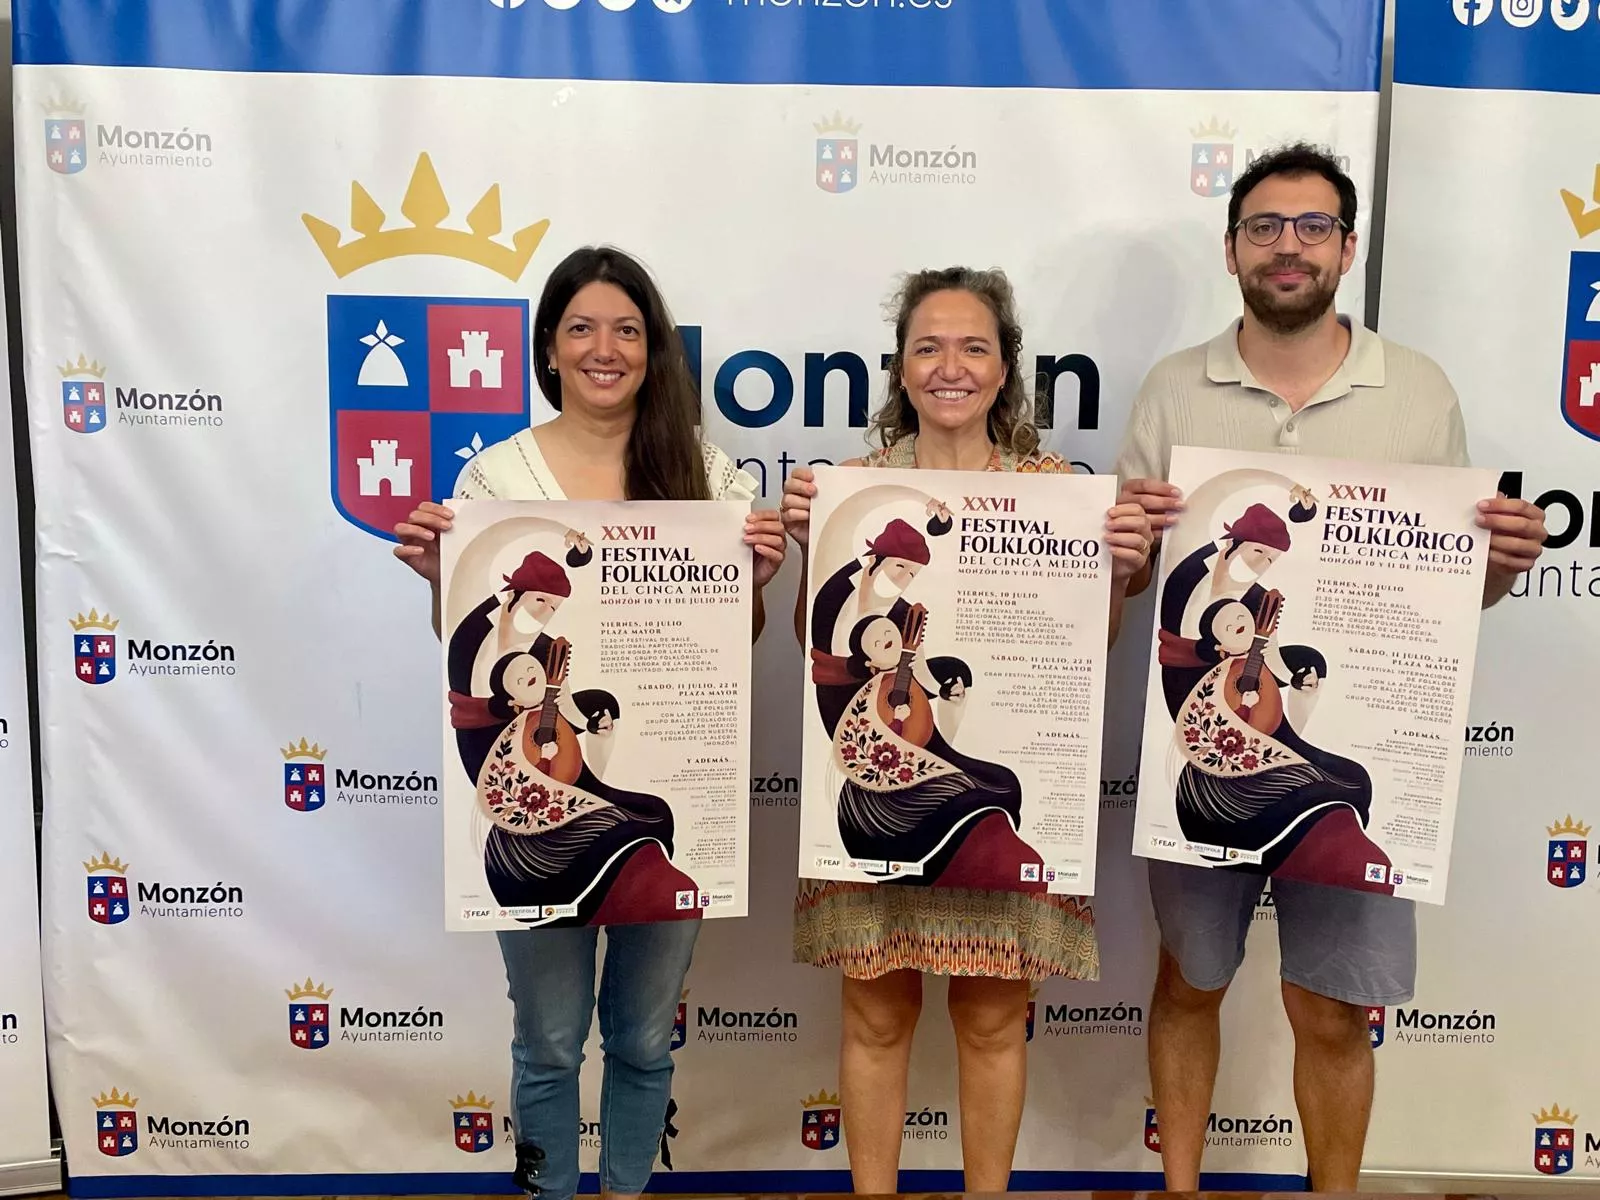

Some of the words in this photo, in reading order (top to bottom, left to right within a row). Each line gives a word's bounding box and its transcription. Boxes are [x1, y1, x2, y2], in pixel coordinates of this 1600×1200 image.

[97, 125, 211, 151] Monzón
[98, 151, 212, 168] Ayuntamiento
[870, 144, 976, 168] Monzón
[869, 170, 976, 185] Ayuntamiento
[116, 387, 222, 411] Monzón
[119, 412, 223, 427] Ayuntamiento
[1328, 484, 1386, 502] XXVII
[962, 496, 1016, 512] XXVII
[1325, 505, 1427, 527] FESTIVAL
[602, 525, 655, 540] XXVII
[961, 518, 1054, 534] FESTIVAL
[960, 535, 1099, 557] FOLKLÓRICO
[1322, 523, 1474, 553] FOLKLÓRICO
[602, 547, 694, 561] FESTIVAL
[959, 555, 986, 565] DEL
[992, 556, 1041, 567] CINCA
[1048, 558, 1098, 569] MEDIO
[1320, 543, 1350, 555] DEL
[1357, 546, 1409, 560] CINCA
[1417, 552, 1473, 565] MEDIO
[601, 561, 739, 582] FOLKLÓRICO
[958, 567, 997, 575] MONZÓN
[1046, 570, 1073, 578] JULIO
[1319, 555, 1361, 566] MONZÓN
[1399, 562, 1412, 570] DE
[1414, 564, 1444, 573] JULIO
[1447, 566, 1472, 576] 2026
[601, 585, 628, 595] DEL
[635, 585, 683, 594] CINCA
[690, 584, 739, 594] MEDIO
[1315, 587, 1344, 595] PLAZA
[1347, 590, 1380, 598] MAYOR
[1376, 584, 1404, 593] JULIO
[128, 640, 234, 661] Monzón
[129, 663, 235, 676] Ayuntamiento
[1392, 659, 1422, 667] PLAZA
[1425, 662, 1458, 671] MAYOR
[336, 769, 437, 791] Monzón
[750, 772, 798, 793] zón
[337, 791, 437, 805] Ayuntamiento
[1158, 840, 1176, 848] FEAF
[138, 882, 242, 903] Monzón
[141, 905, 243, 918] Ayuntamiento
[341, 1006, 443, 1027] Monzón
[698, 1007, 797, 1028] Monzón
[1045, 1002, 1142, 1023] Monzón
[1396, 1009, 1495, 1030] Monzón
[341, 1030, 443, 1043] Ayuntamiento
[698, 1030, 797, 1043] Ayuntamiento
[1044, 1024, 1142, 1037] Ayuntamiento
[1396, 1031, 1494, 1043] Ayuntamiento
[904, 1107, 948, 1126] zón
[148, 1116, 249, 1136] Monzón
[149, 1136, 249, 1149] Ayuntamiento
[1205, 1135, 1293, 1149] yuntamiento
